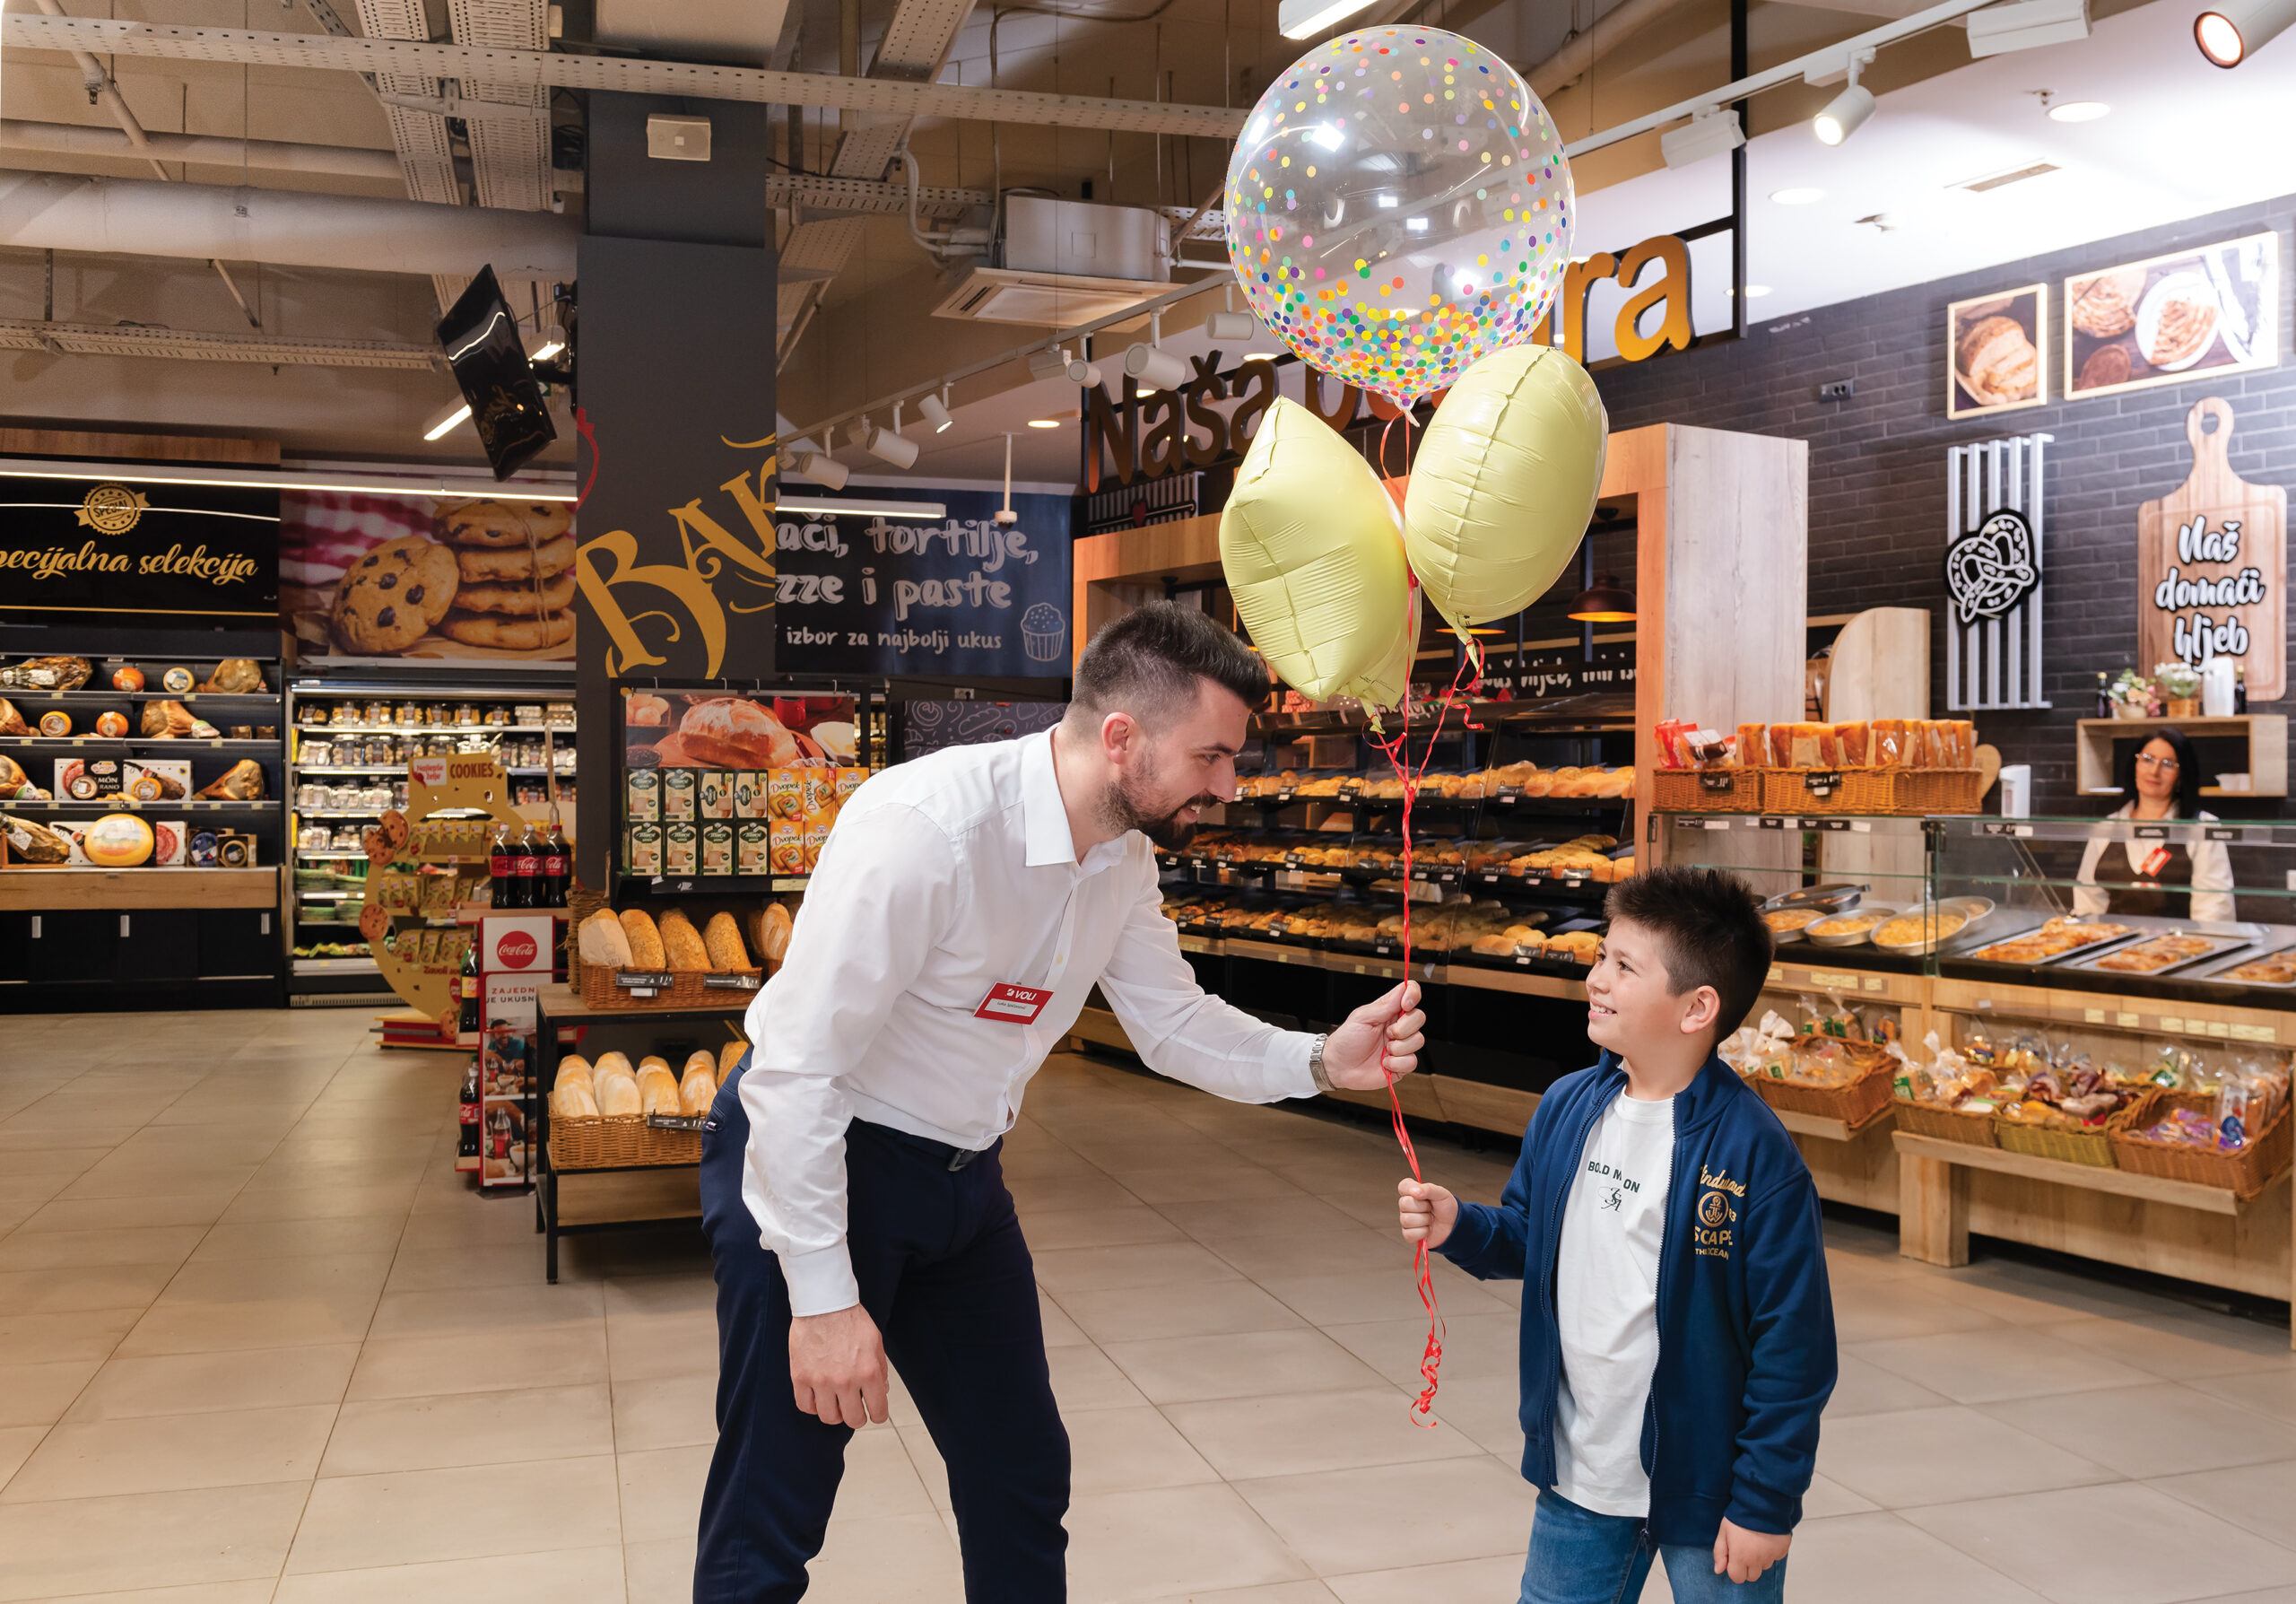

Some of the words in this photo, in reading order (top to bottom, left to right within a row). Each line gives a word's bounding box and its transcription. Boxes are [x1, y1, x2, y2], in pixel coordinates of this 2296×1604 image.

[1085, 349, 1280, 494] Naša
[776, 513, 849, 558] ači,
[864, 516, 1039, 572] tortilje,
[2178, 514, 2242, 565] Naš
[138, 543, 258, 585] selekcija
[576, 455, 776, 680] BAK
[775, 573, 845, 605] zze
[862, 567, 876, 606] i
[892, 571, 1013, 622] paste
[787, 626, 839, 646] izbor
[848, 631, 868, 647] za
[877, 629, 950, 655] najbolji
[958, 630, 1002, 649] ukus
[2173, 612, 2249, 674] hljeb
[98, 775, 118, 783] MÓN
[450, 763, 494, 783] COOKIES
[770, 781, 800, 794] Dvopek
[838, 782, 862, 793] Dvop
[804, 780, 817, 813] Dvopek
[772, 834, 802, 846] Dvopek
[806, 835, 828, 846] Dvop
[491, 987, 535, 995] ZAJEDN
[1015, 989, 1038, 1001] VOLI
[1587, 1161, 1610, 1175] BOD
[1700, 1164, 1747, 1198] indward
